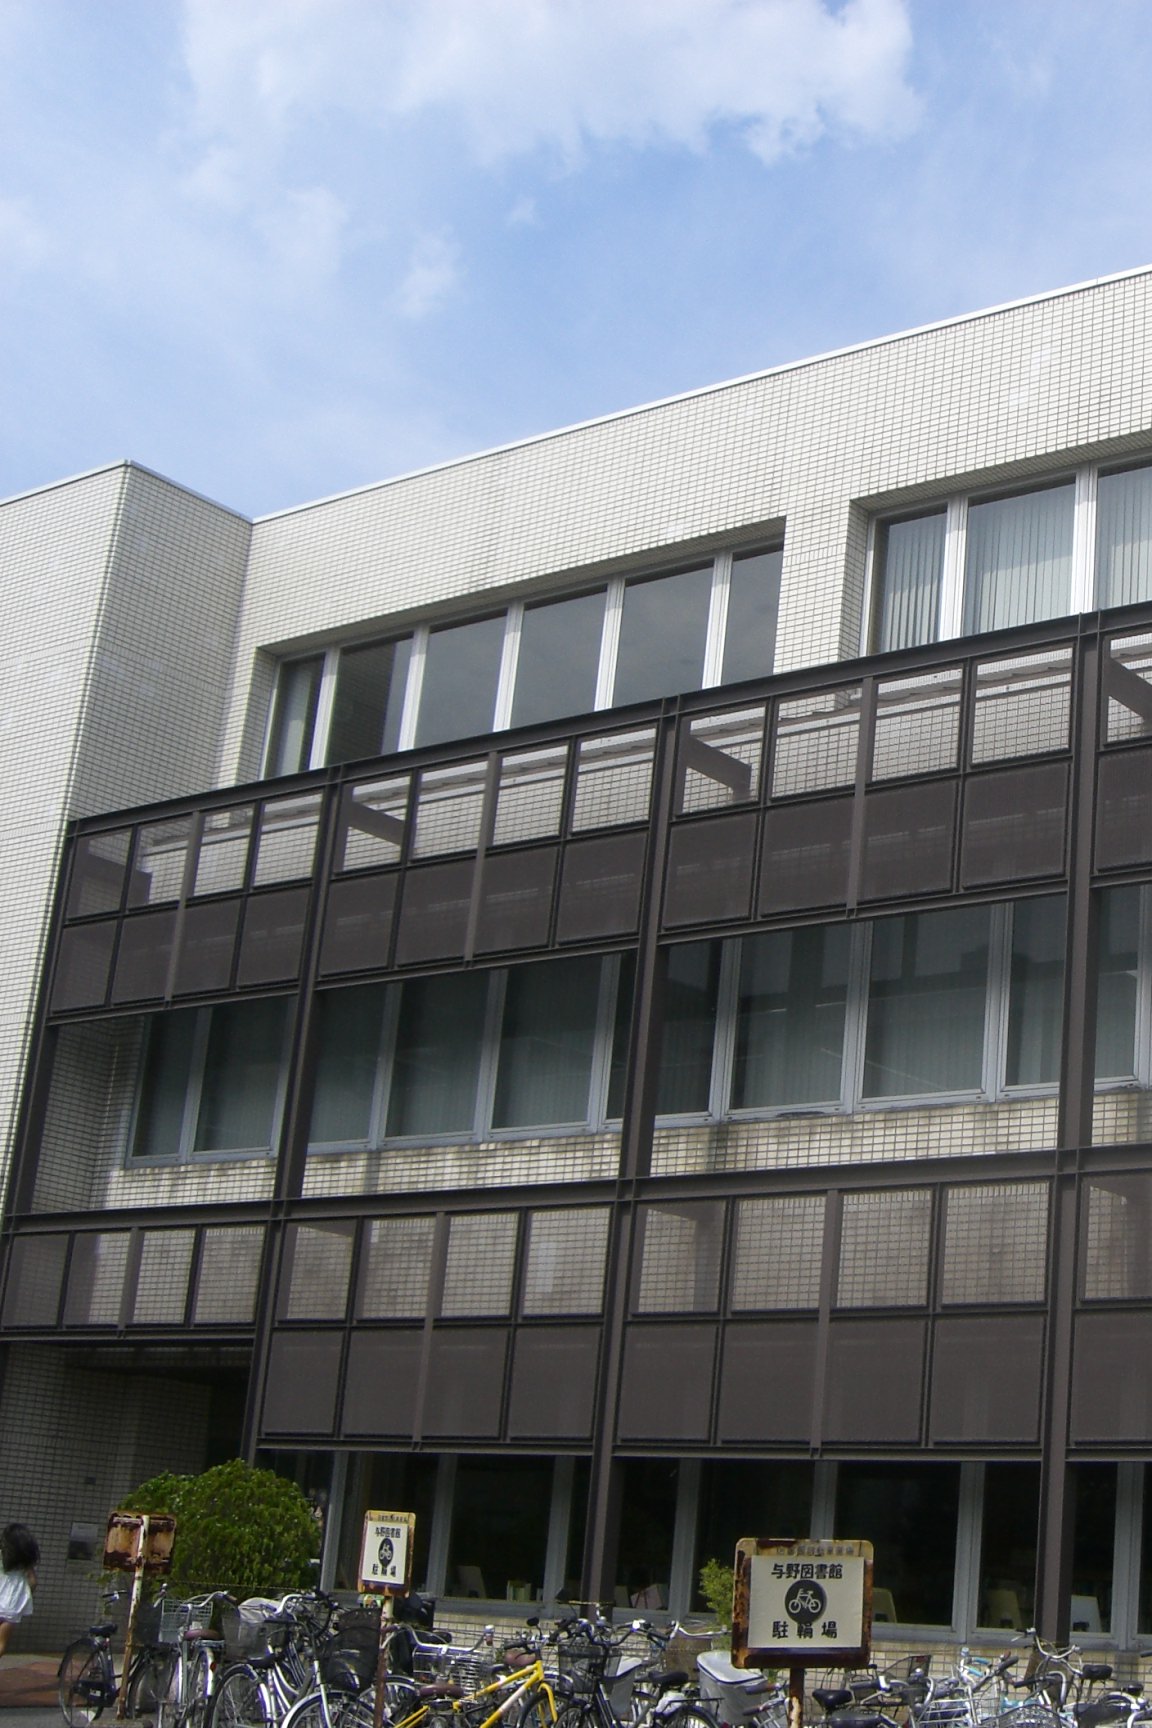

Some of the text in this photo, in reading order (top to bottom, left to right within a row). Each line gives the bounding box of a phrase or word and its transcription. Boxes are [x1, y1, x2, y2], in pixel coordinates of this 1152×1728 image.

[771, 1563, 843, 1579] 与野図書館
[772, 1621, 837, 1639] 駐輪場
